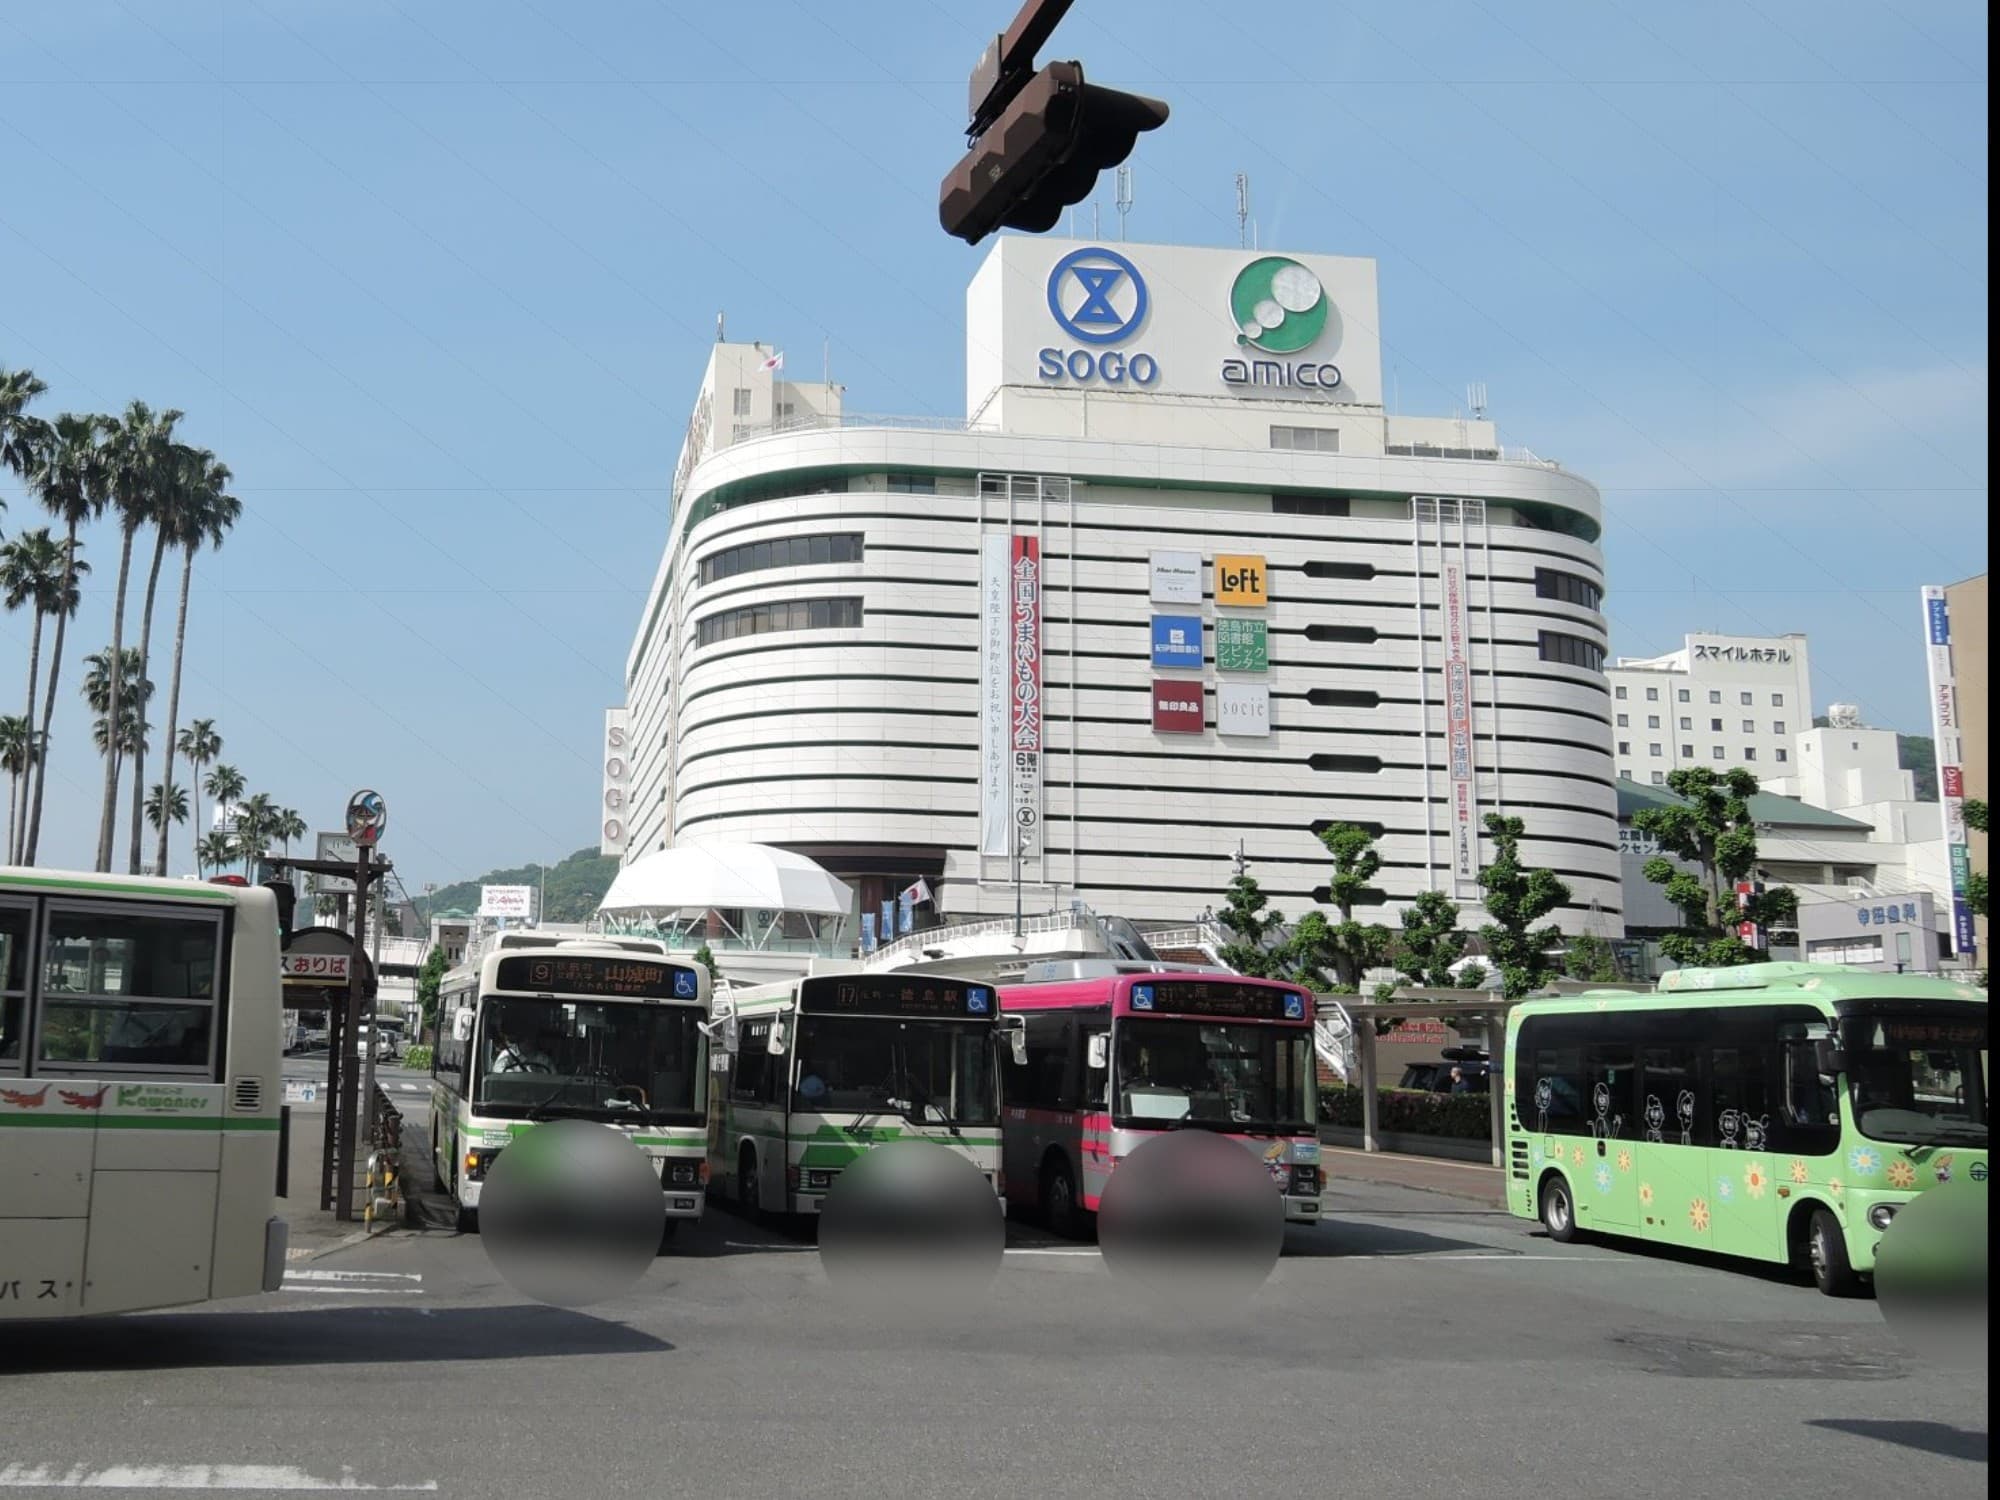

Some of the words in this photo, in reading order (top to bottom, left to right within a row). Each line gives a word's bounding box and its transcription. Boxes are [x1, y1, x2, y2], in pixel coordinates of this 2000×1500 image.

[1039, 348, 1158, 384] SOGO
[1221, 359, 1342, 389] amico
[1014, 557, 1038, 750] 全国うまいもの大会
[1219, 645, 1264, 657] シビック
[1695, 644, 1791, 664] スマイルホテル
[1220, 657, 1264, 669] センター
[604, 726, 625, 841] SOGO
[535, 964, 549, 979] 9
[604, 966, 664, 983] 山城町
